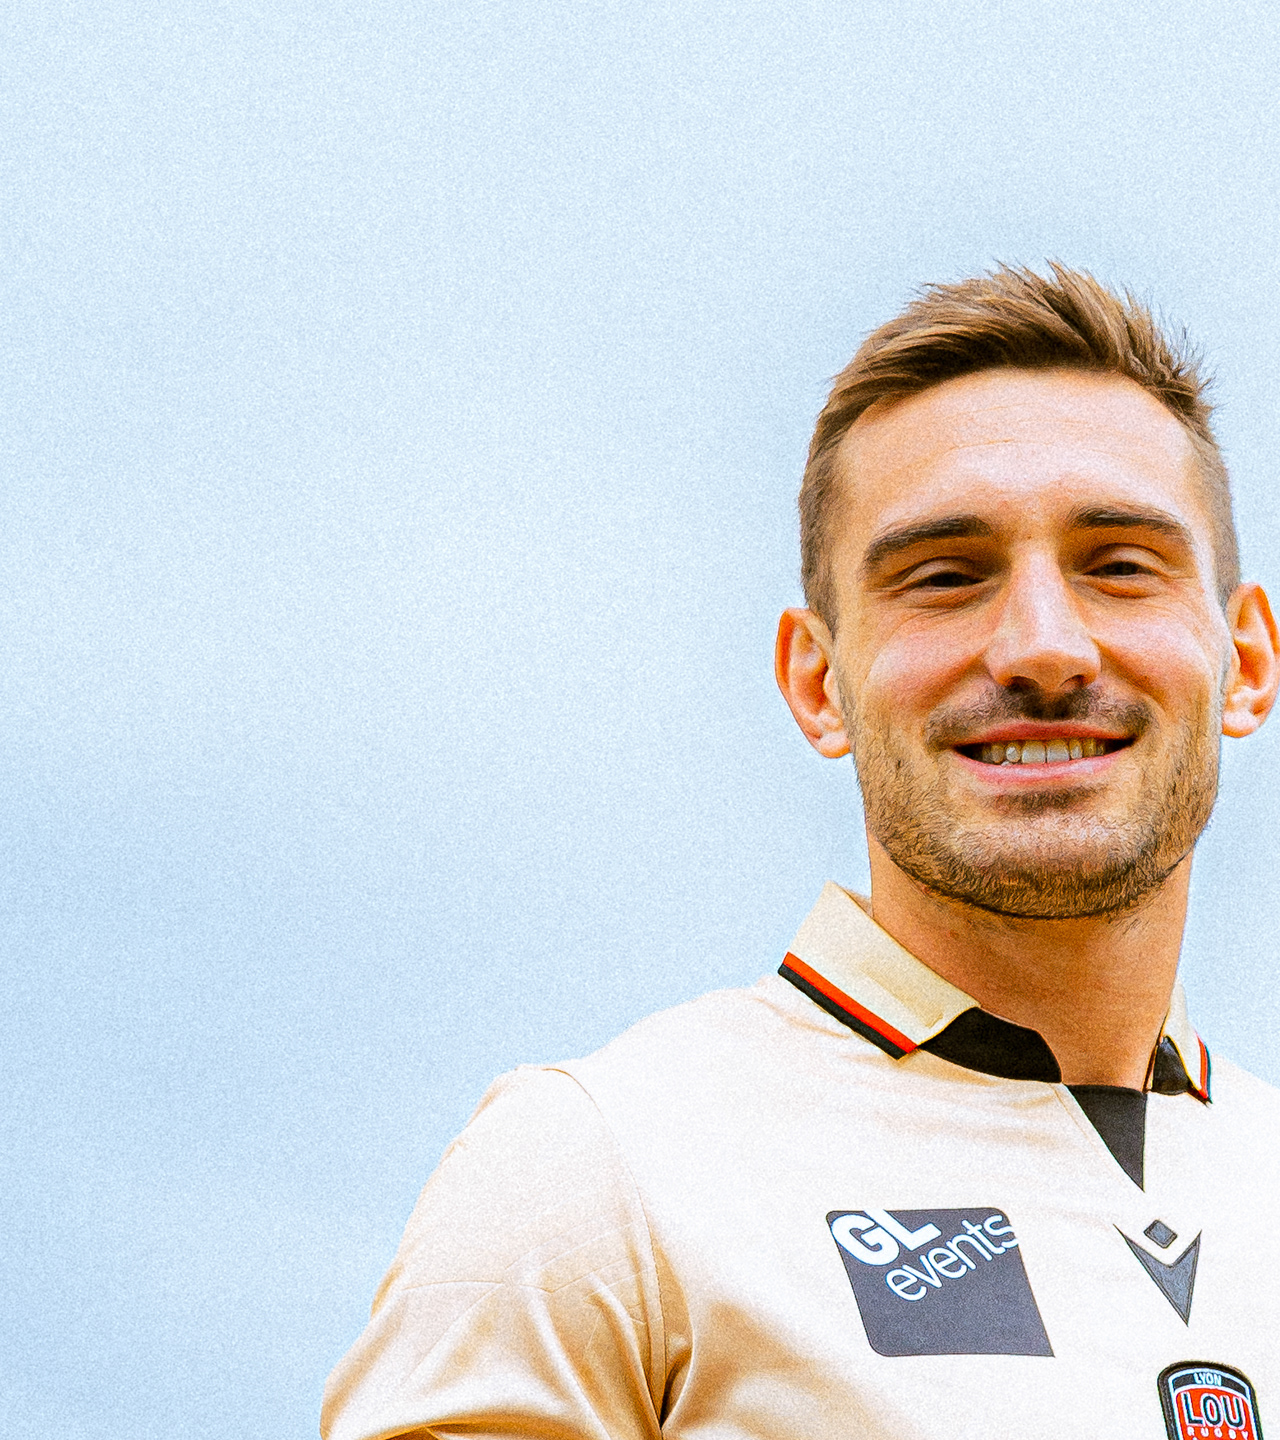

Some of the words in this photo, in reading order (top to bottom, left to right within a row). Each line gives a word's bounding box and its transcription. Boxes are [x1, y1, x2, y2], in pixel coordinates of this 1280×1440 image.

[831, 1210, 942, 1266] GL
[885, 1215, 1019, 1301] events
[1193, 1372, 1222, 1387] LYON
[1181, 1392, 1246, 1430] LOU
